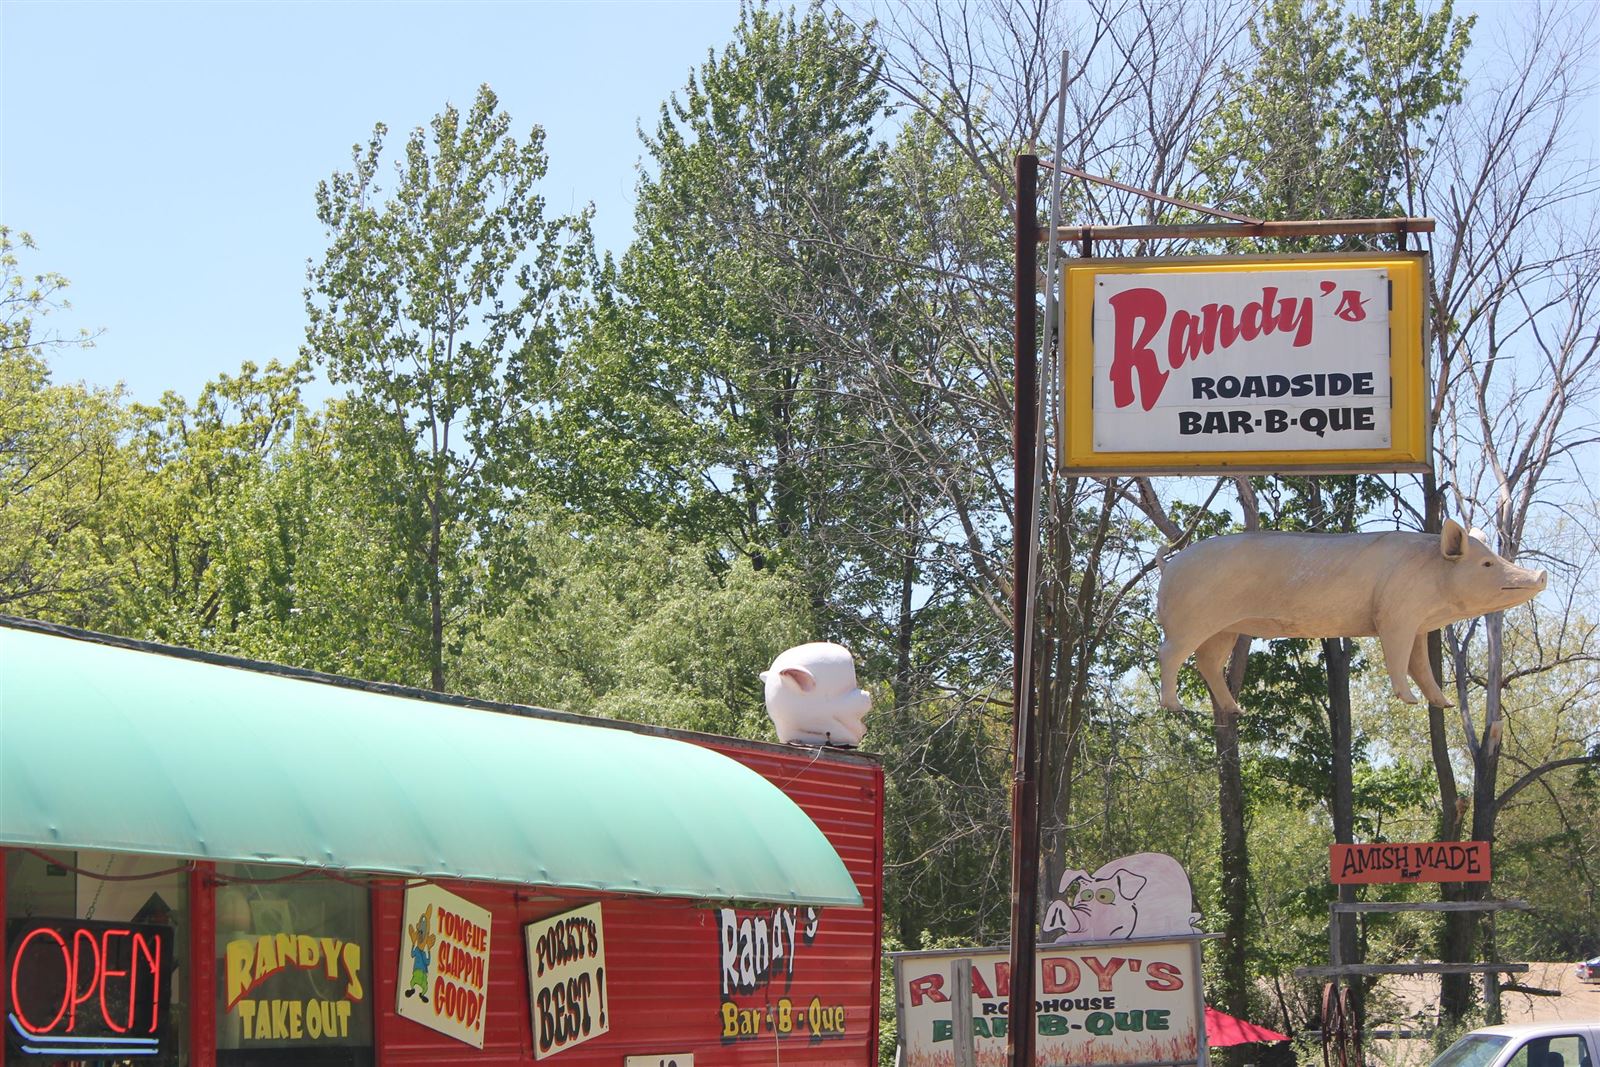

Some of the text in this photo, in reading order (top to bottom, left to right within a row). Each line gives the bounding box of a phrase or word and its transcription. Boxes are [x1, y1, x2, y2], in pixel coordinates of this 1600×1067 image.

[1108, 280, 1372, 411] Randy's
[1191, 372, 1375, 400] ROADSIDE
[1341, 846, 1481, 877] AMISH MADE
[437, 906, 487, 952] TONGUE
[536, 917, 598, 977] PORKY'S
[10, 927, 162, 1034] OPEN
[226, 933, 364, 1011] RANDYS
[437, 940, 485, 990] SLAPPIN
[239, 998, 351, 1040] TAKE OUT
[434, 975, 484, 1032] GOOD!
